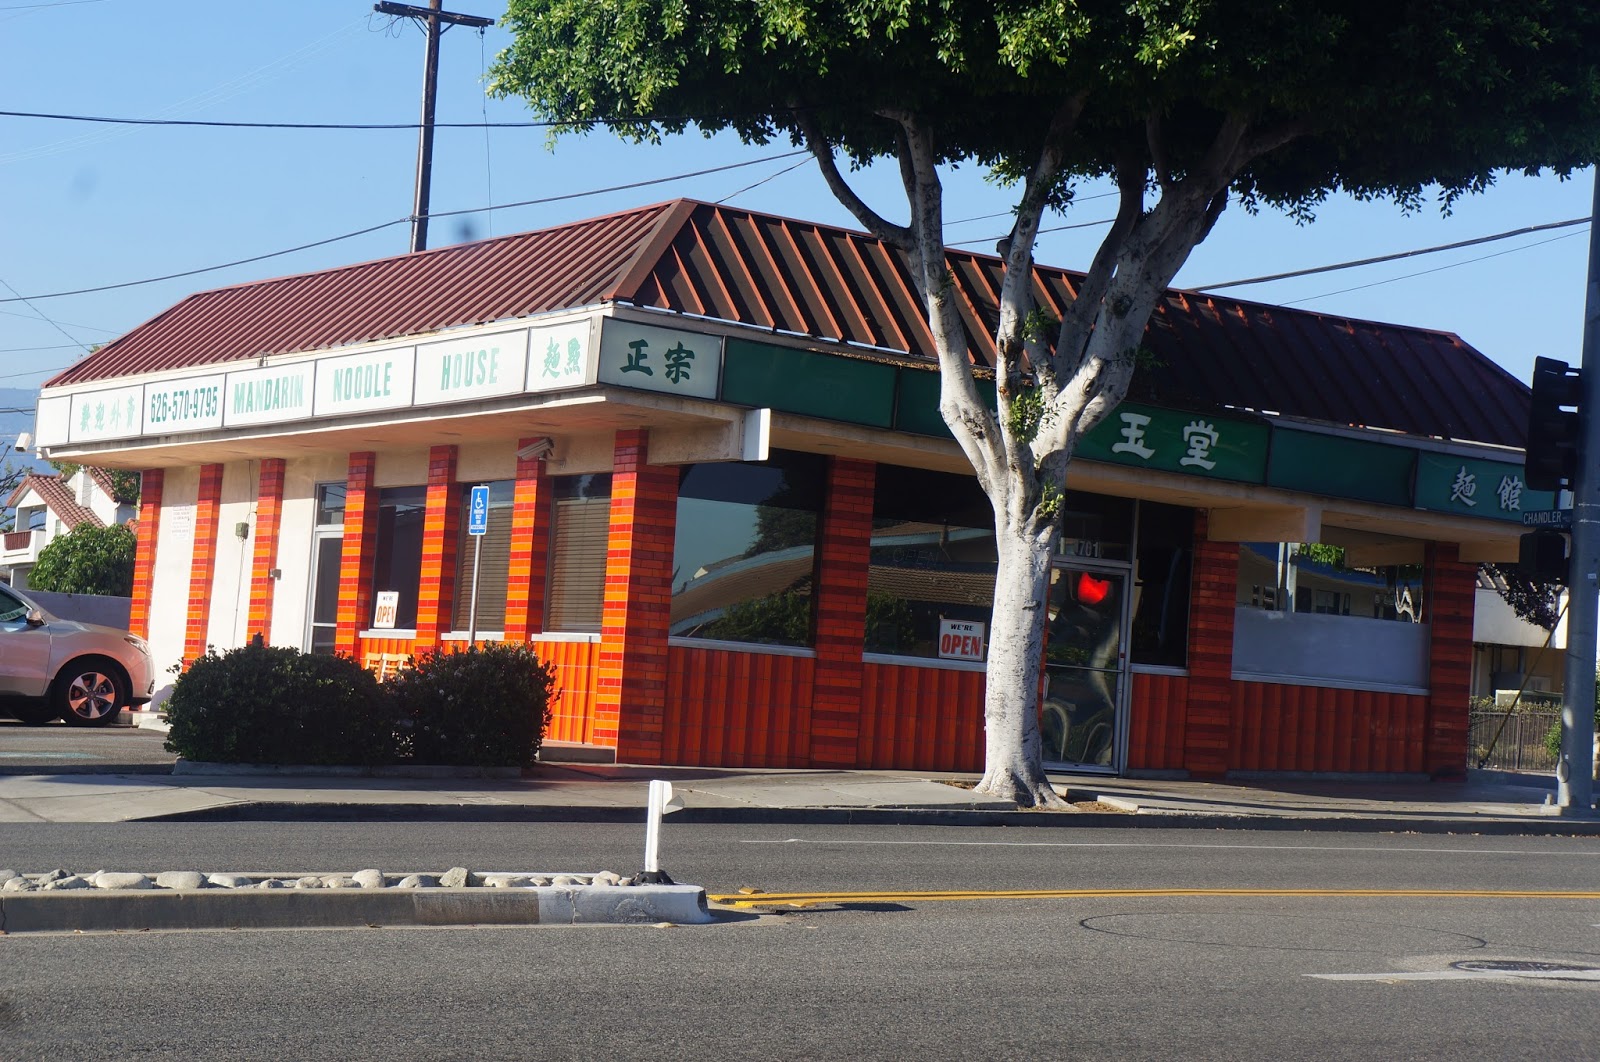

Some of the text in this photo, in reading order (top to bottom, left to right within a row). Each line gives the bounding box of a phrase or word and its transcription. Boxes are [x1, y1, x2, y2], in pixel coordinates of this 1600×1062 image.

[619, 338, 695, 385] 正宗
[233, 347, 500, 415] MANDARIN NOODLE HOUSE
[150, 386, 218, 423] 626-570-9795
[1450, 465, 1523, 512] 麵館
[1523, 511, 1562, 525] CHANDLER
[376, 605, 395, 623] OPEN
[950, 623, 974, 631] WE'RE
[941, 633, 982, 657] OPEN
